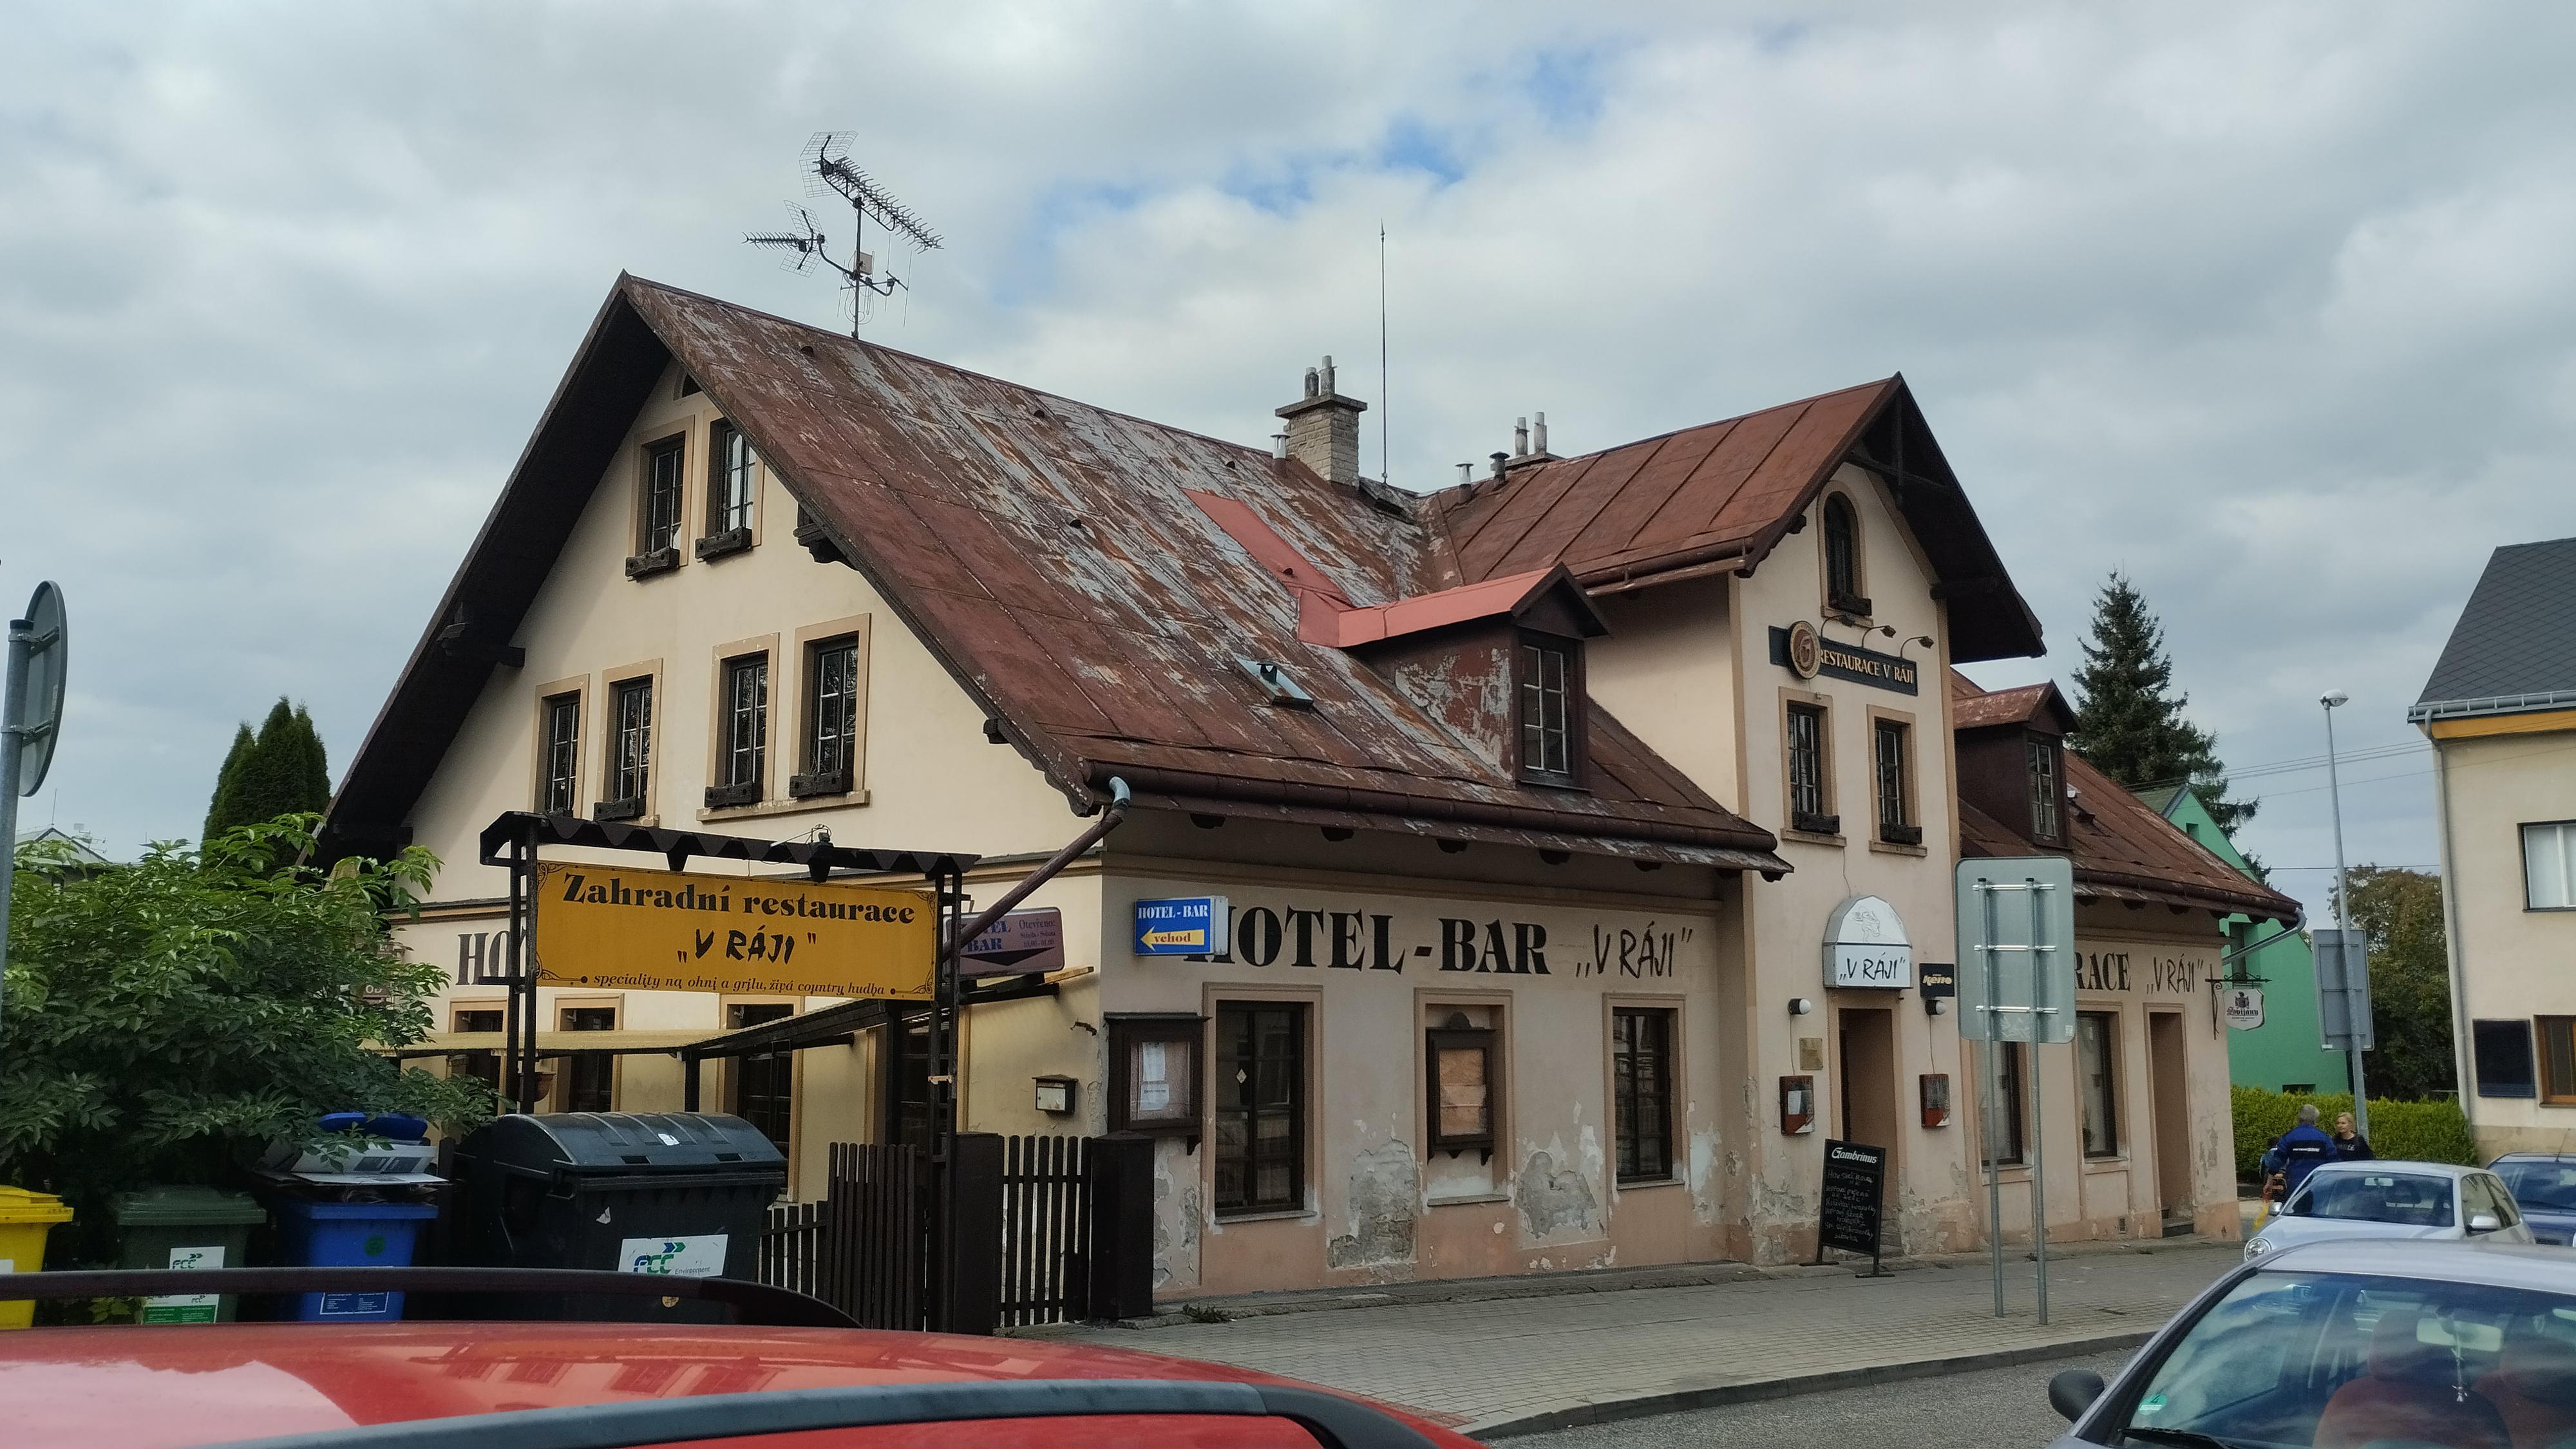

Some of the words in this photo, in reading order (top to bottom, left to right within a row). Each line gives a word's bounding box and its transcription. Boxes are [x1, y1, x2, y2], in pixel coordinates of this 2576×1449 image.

[1820, 649, 1880, 676] RESTAURACE
[1882, 663, 1890, 678] V
[1894, 664, 1913, 684] RÁJI
[563, 872, 730, 912] Zahradní
[743, 893, 915, 924] restaurace
[967, 938, 1003, 952] BAR
[1154, 933, 1191, 943] vchod
[455, 926, 526, 985] HO
[594, 973, 660, 989] speciality
[665, 978, 682, 989] na
[688, 976, 717, 990] ohni
[734, 978, 766, 992] grilu,
[769, 980, 793, 992] živá
[797, 981, 845, 996] country
[848, 982, 884, 996] hudba
[2227, 1007, 2259, 1016] Svijany
[1831, 1147, 1878, 1164] Gambrinus
[173, 1259, 196, 1269] FCC
[634, 1255, 674, 1274] FCC
[675, 1267, 710, 1275] Environment
